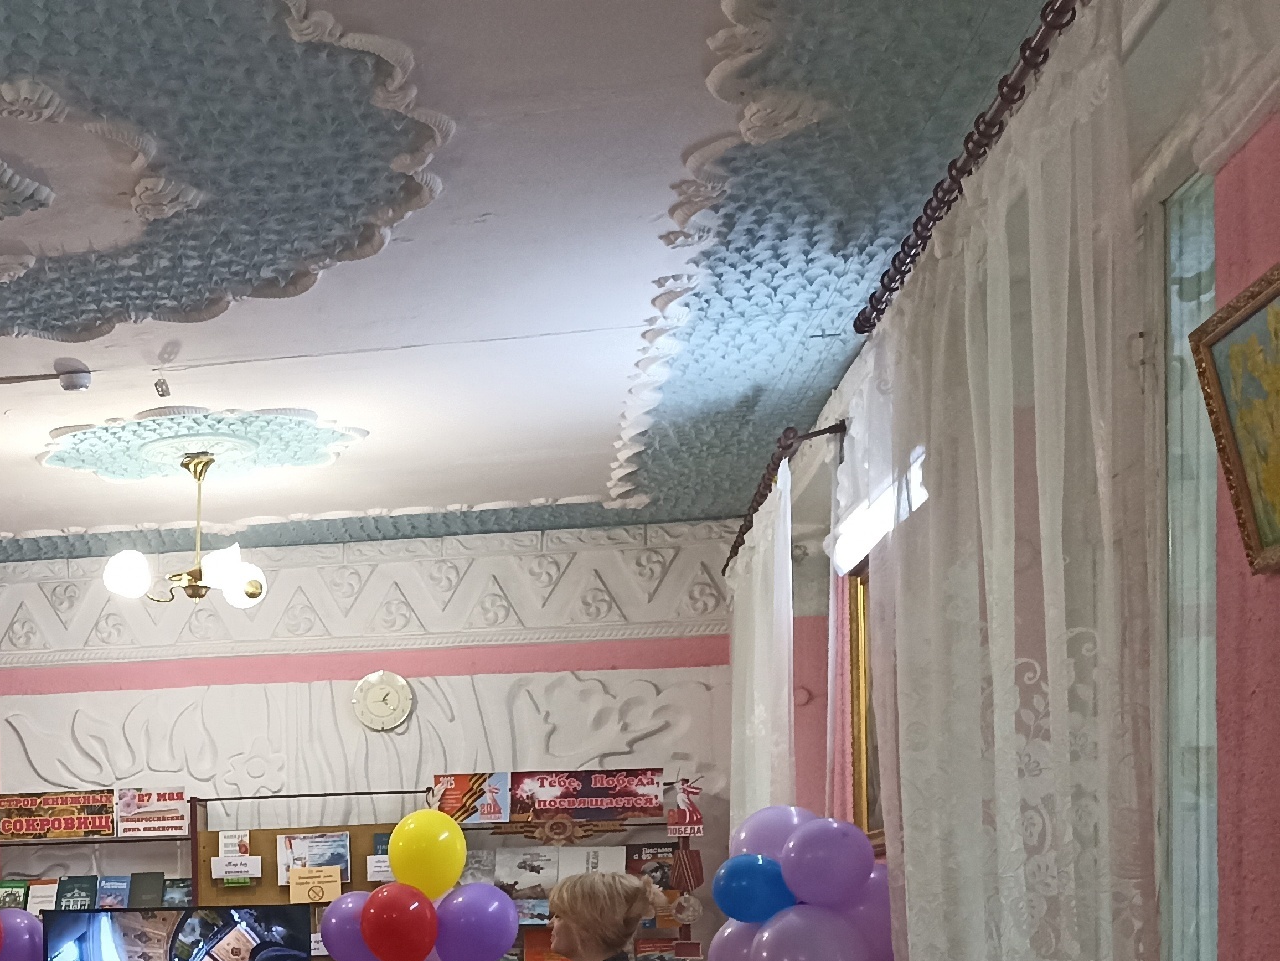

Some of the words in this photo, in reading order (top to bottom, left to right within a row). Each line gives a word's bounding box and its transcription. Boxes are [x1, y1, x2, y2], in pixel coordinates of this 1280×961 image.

[537, 774, 582, 790] Тебе,
[591, 773, 660, 792] Победа,
[42, 793, 113, 808] КНИЖНЫХ
[137, 792, 153, 803] 27
[536, 794, 660, 810] посвящается!
[0, 814, 113, 834] СОКРОВИЩ
